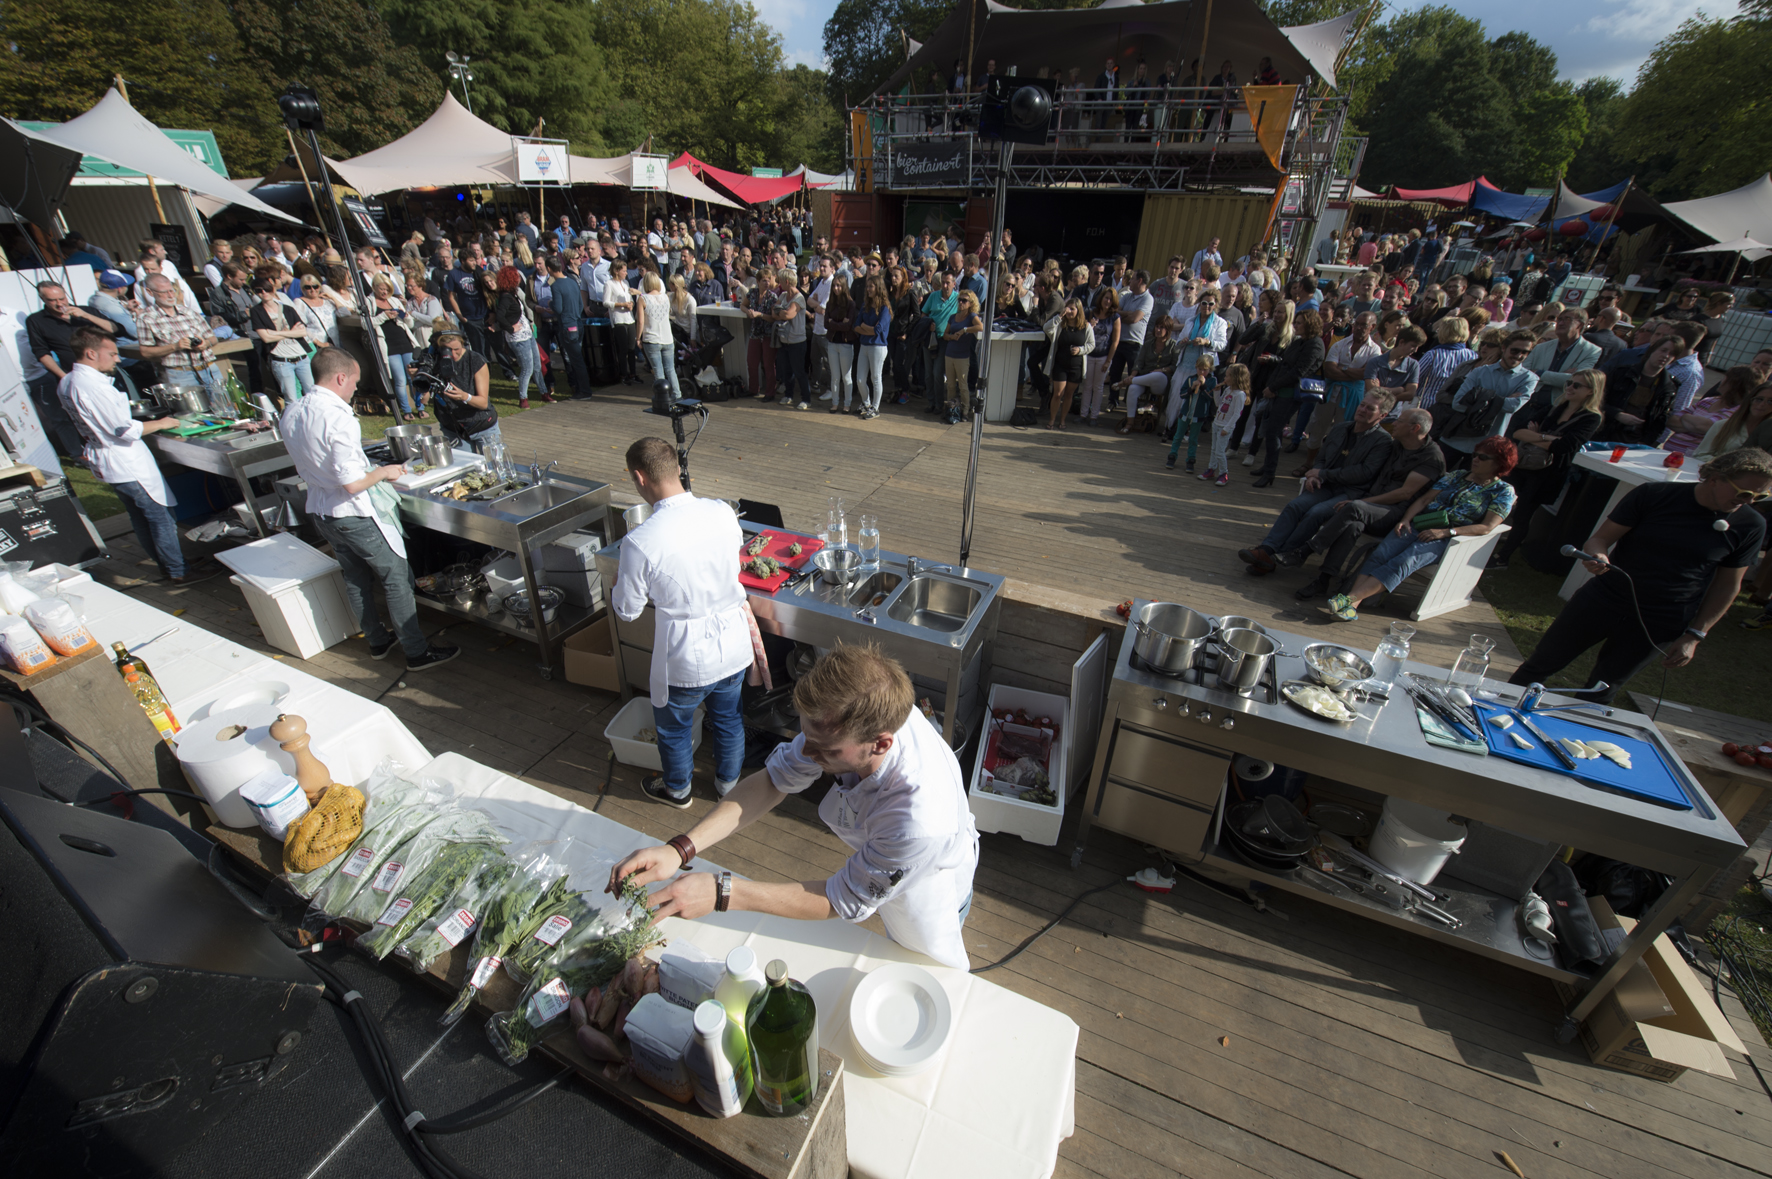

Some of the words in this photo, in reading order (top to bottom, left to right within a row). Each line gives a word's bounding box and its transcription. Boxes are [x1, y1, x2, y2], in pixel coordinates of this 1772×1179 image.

[897, 152, 917, 168] bier
[904, 152, 964, 176] containert
[459, 911, 474, 927] ZEGRO
[548, 922, 563, 931] Salie
[550, 986, 562, 1008] DRAGON
